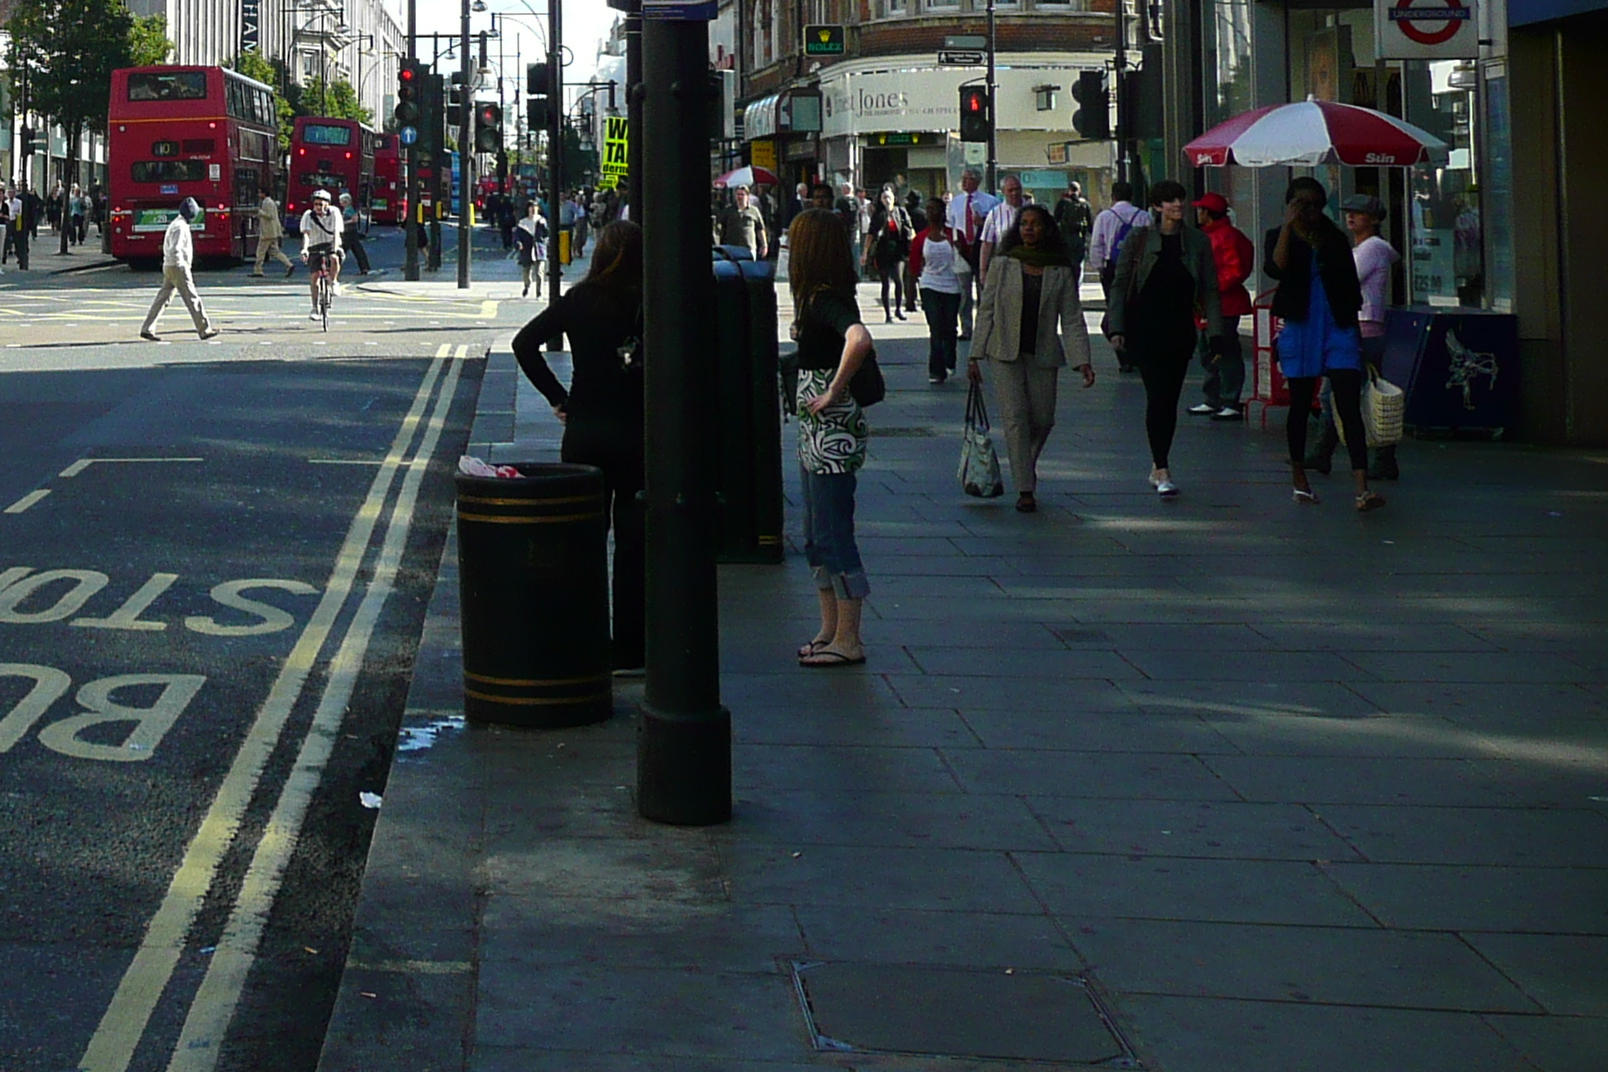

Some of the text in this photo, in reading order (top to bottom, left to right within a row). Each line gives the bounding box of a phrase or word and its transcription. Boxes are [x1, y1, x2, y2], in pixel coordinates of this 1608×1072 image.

[1393, 10, 1466, 18] UNDERGROUND
[807, 42, 842, 52] ROLEX
[856, 88, 908, 118] Jones
[607, 118, 628, 140] W
[605, 142, 626, 163] TA
[1364, 151, 1395, 164] Sun
[602, 163, 626, 174] derm
